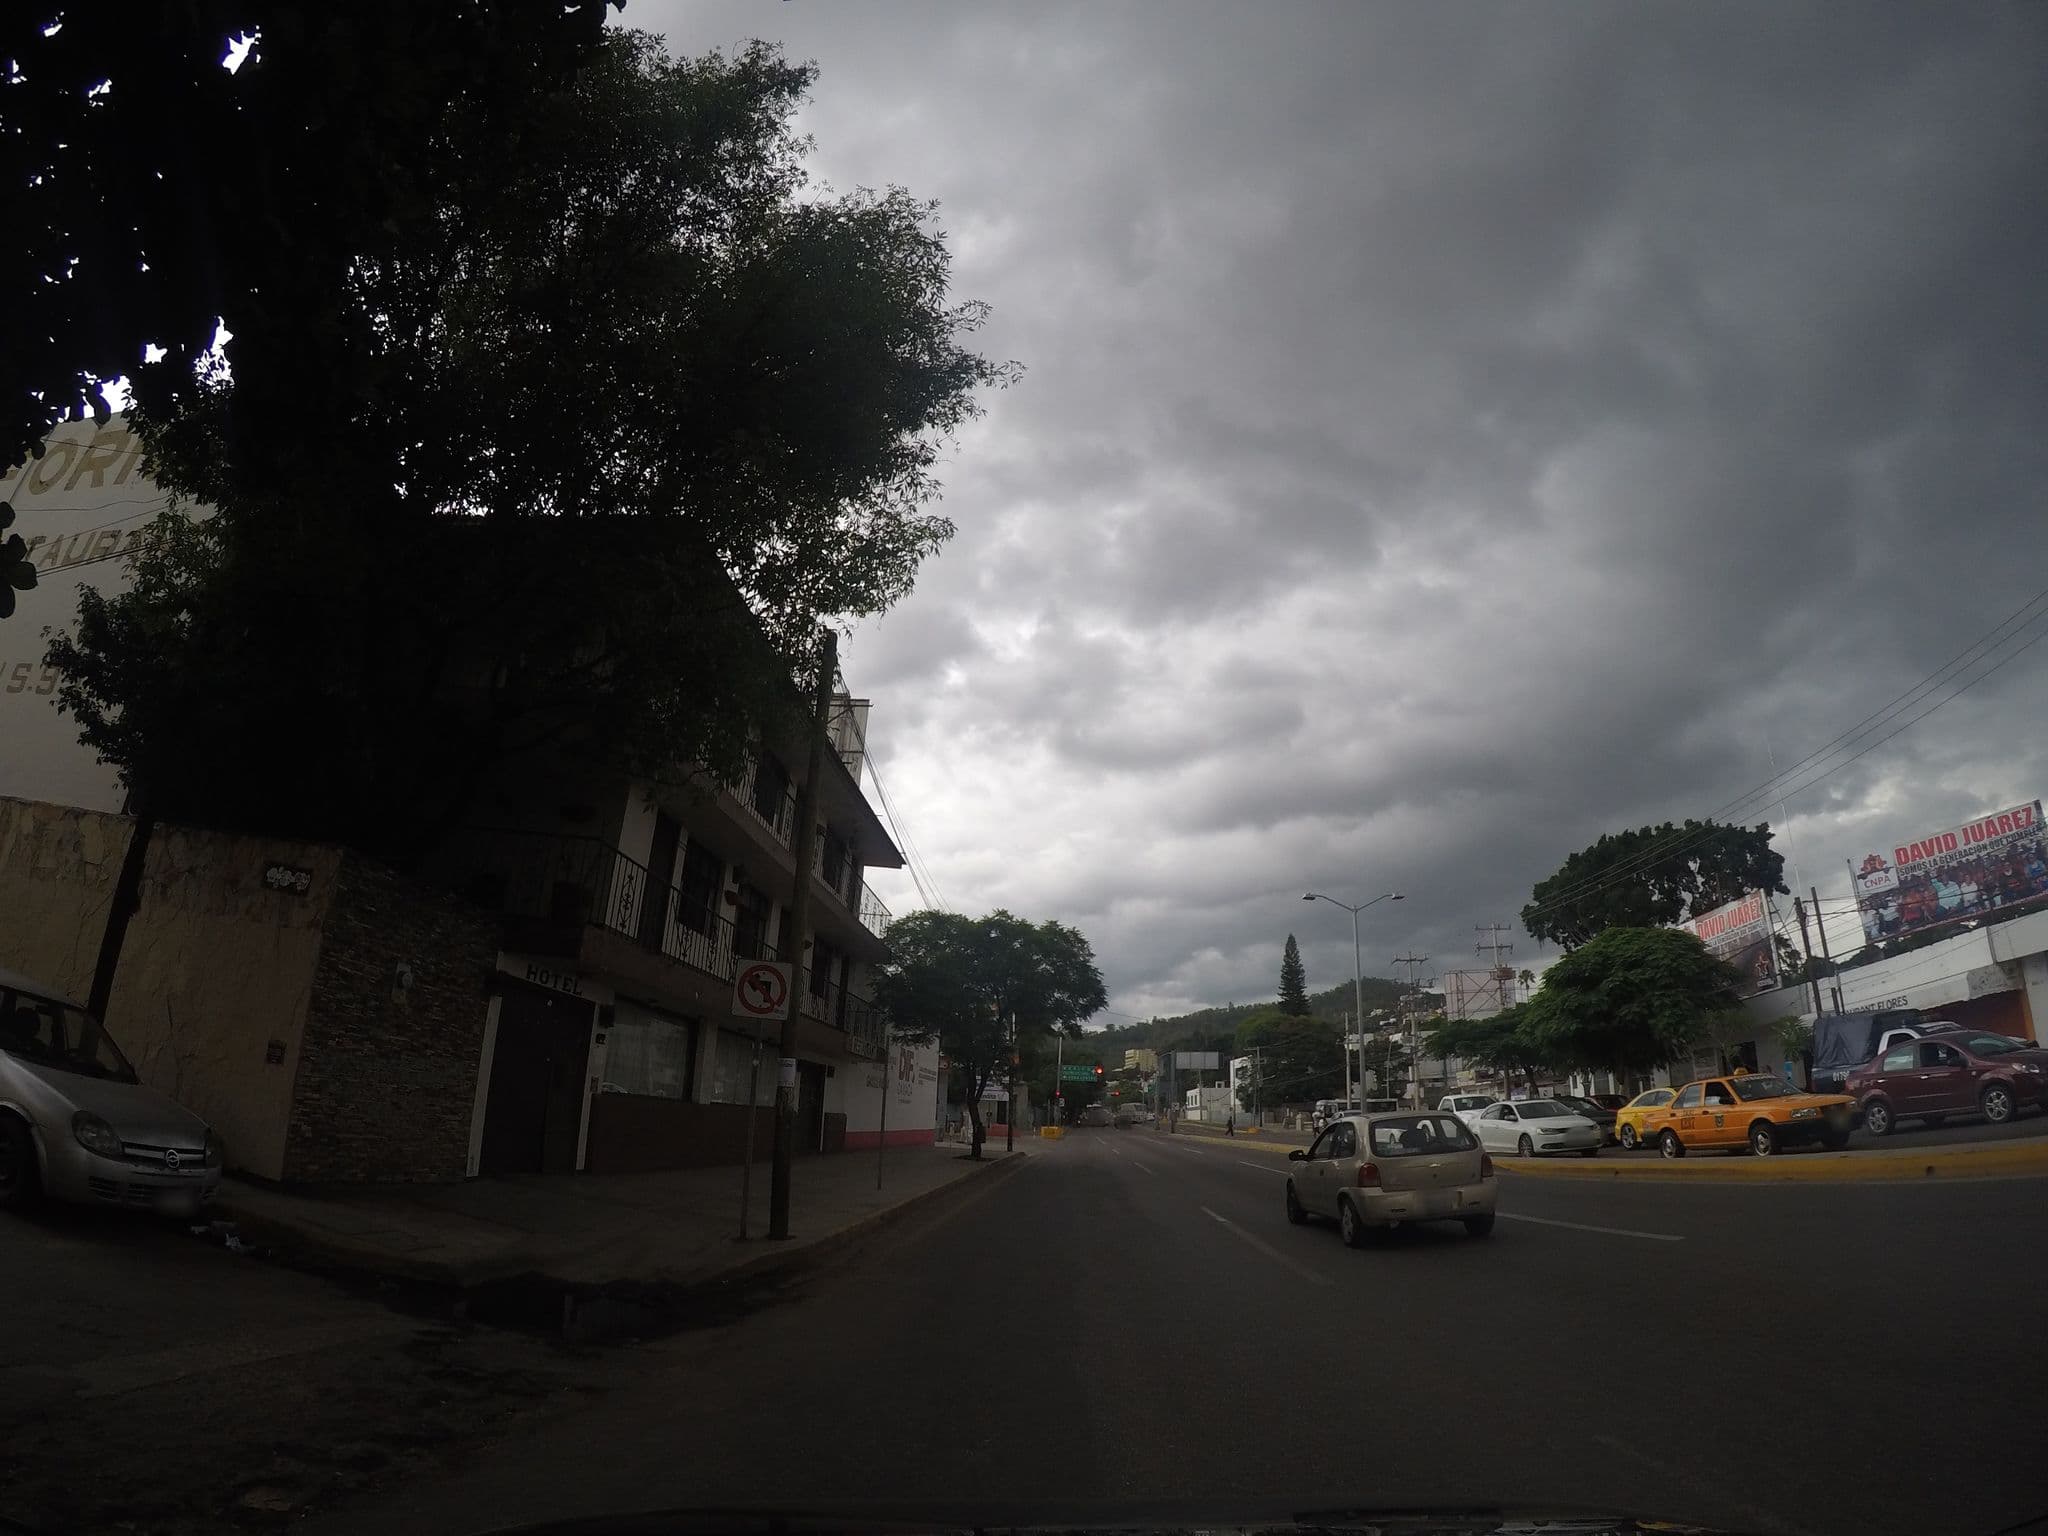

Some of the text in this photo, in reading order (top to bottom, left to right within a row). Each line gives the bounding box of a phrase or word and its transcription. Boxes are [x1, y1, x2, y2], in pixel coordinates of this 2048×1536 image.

[1895, 807, 2033, 866] DAVID JUÁREZ
[1696, 917, 1726, 941] DAVID
[526, 964, 583, 996] HOTEL
[1877, 995, 1908, 1010] FLORES
